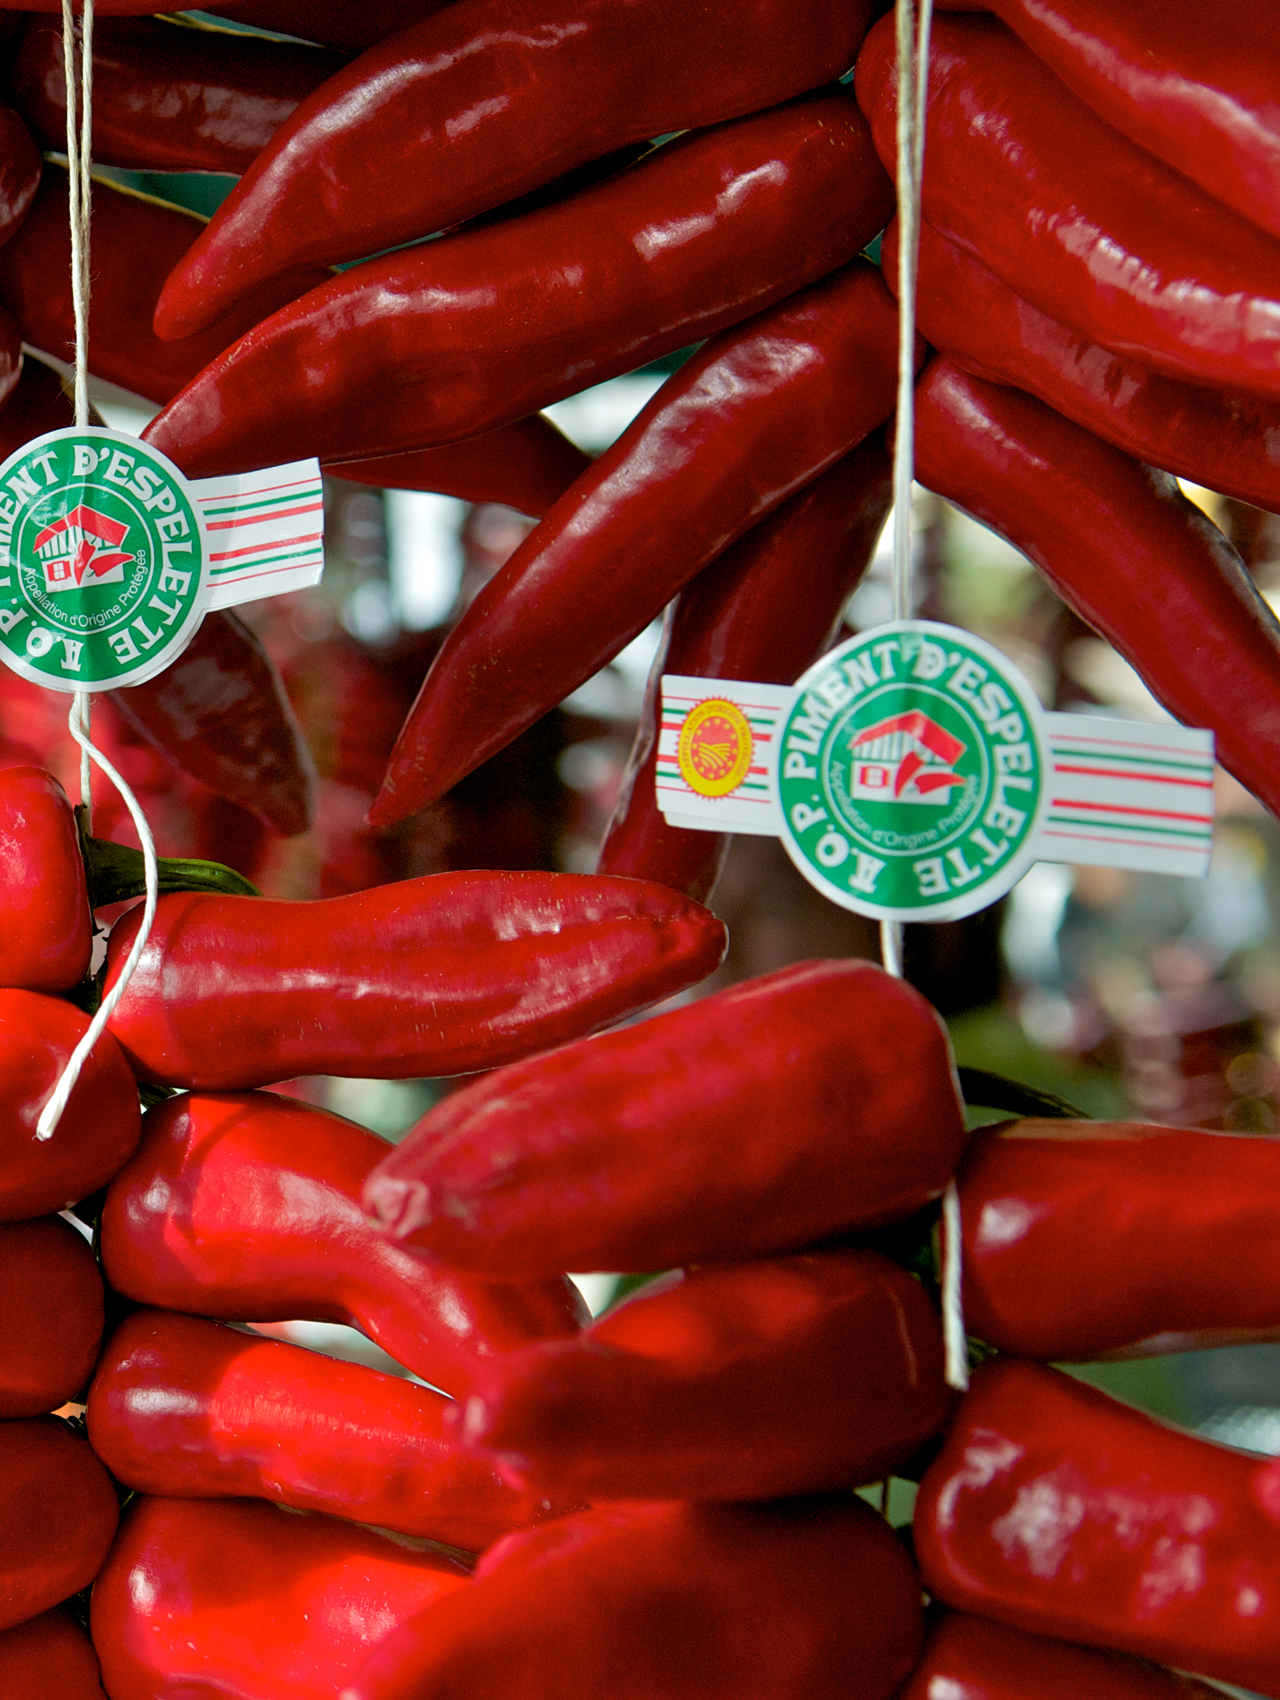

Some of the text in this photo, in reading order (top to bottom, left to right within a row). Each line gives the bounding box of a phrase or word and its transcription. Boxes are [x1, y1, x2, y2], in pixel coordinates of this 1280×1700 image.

[23, 549, 148, 627] Appellation d'Origine Protégée
[72, 444, 193, 664] D'ESPELETTE
[782, 639, 901, 781] PIMENT
[910, 640, 1035, 898] D'ESPELETTE
